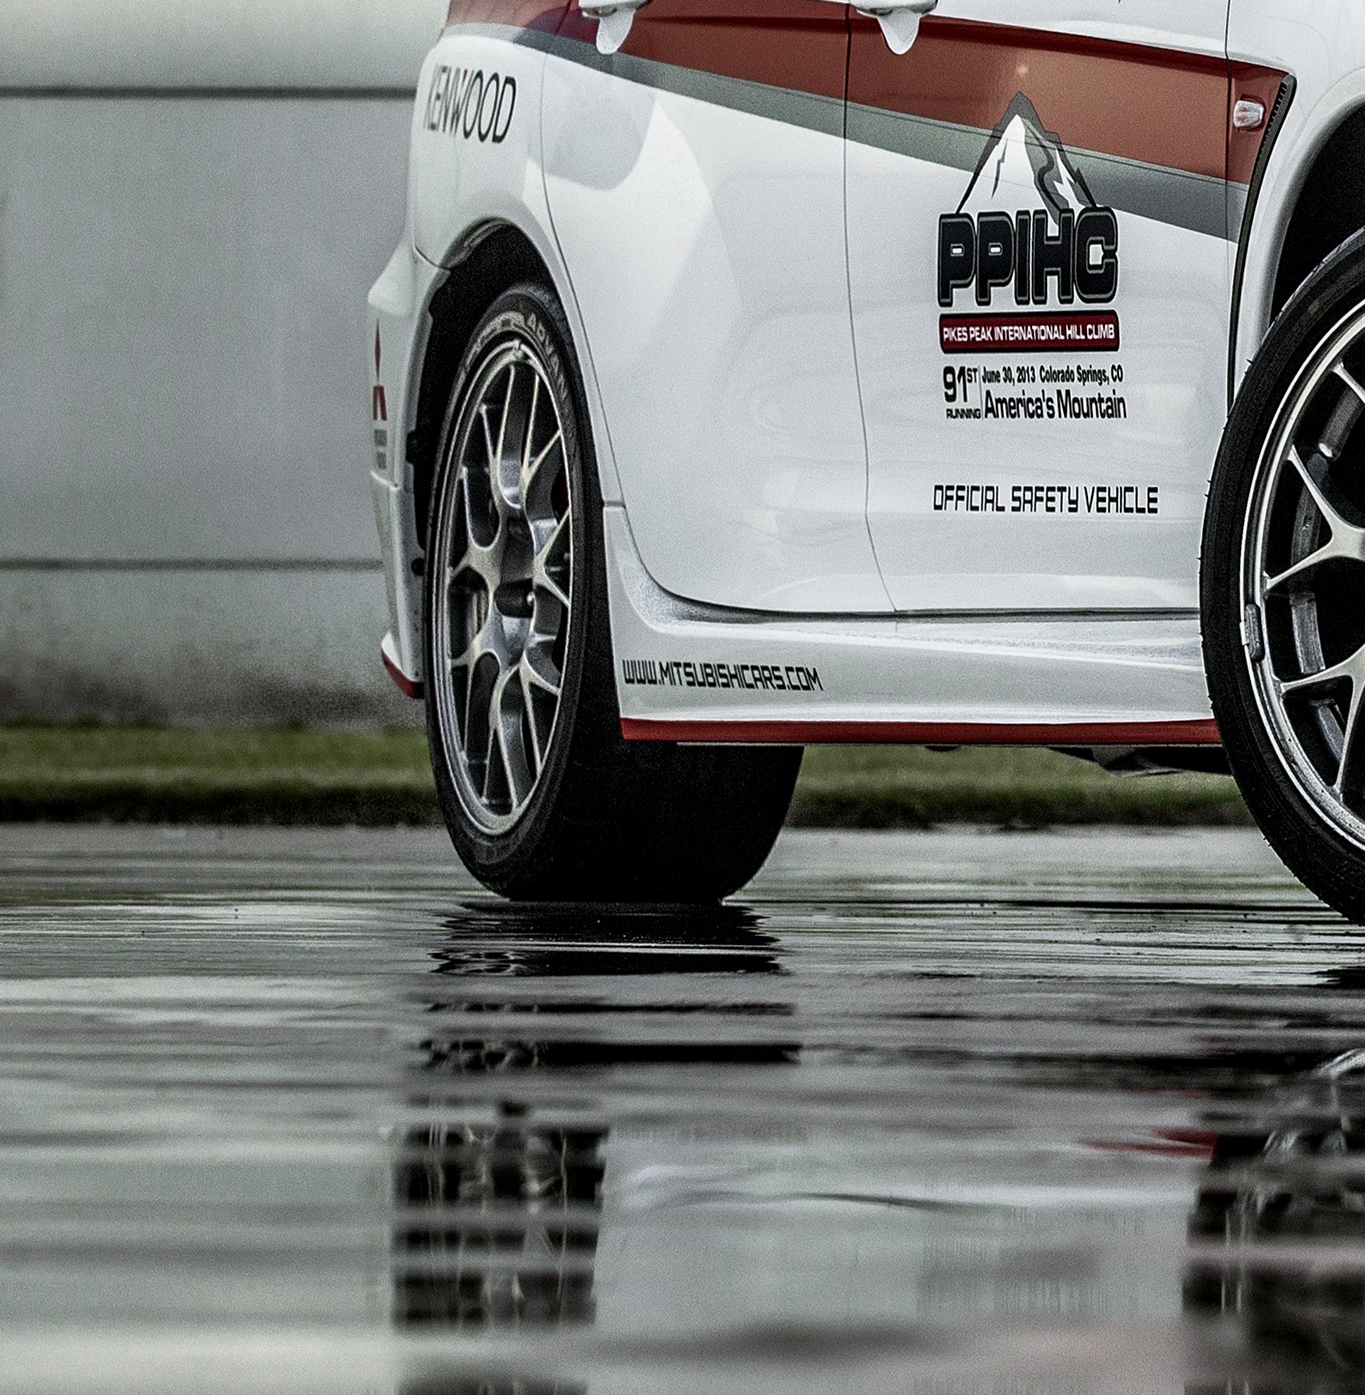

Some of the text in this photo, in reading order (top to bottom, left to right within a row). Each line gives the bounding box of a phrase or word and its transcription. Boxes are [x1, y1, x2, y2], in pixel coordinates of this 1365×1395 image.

[425, 64, 517, 145] ENWOOD
[937, 206, 1119, 306] PPIHC
[943, 323, 1115, 342] PIKES PEAK INTERNATIONAL HILL CLIMB
[982, 366, 1001, 384] June
[1002, 366, 1016, 386] 30,
[1017, 366, 1035, 383] 2013
[1039, 365, 1075, 384] Colorado
[1076, 364, 1110, 386] Springs,
[1111, 364, 1124, 383] CO
[946, 388, 1127, 419] RUNNING America's Mountain
[933, 484, 1159, 514] OFFICIAL SAFETY VEHICLE
[622, 659, 824, 692] WWW.MITSUBISHICARS.COM
